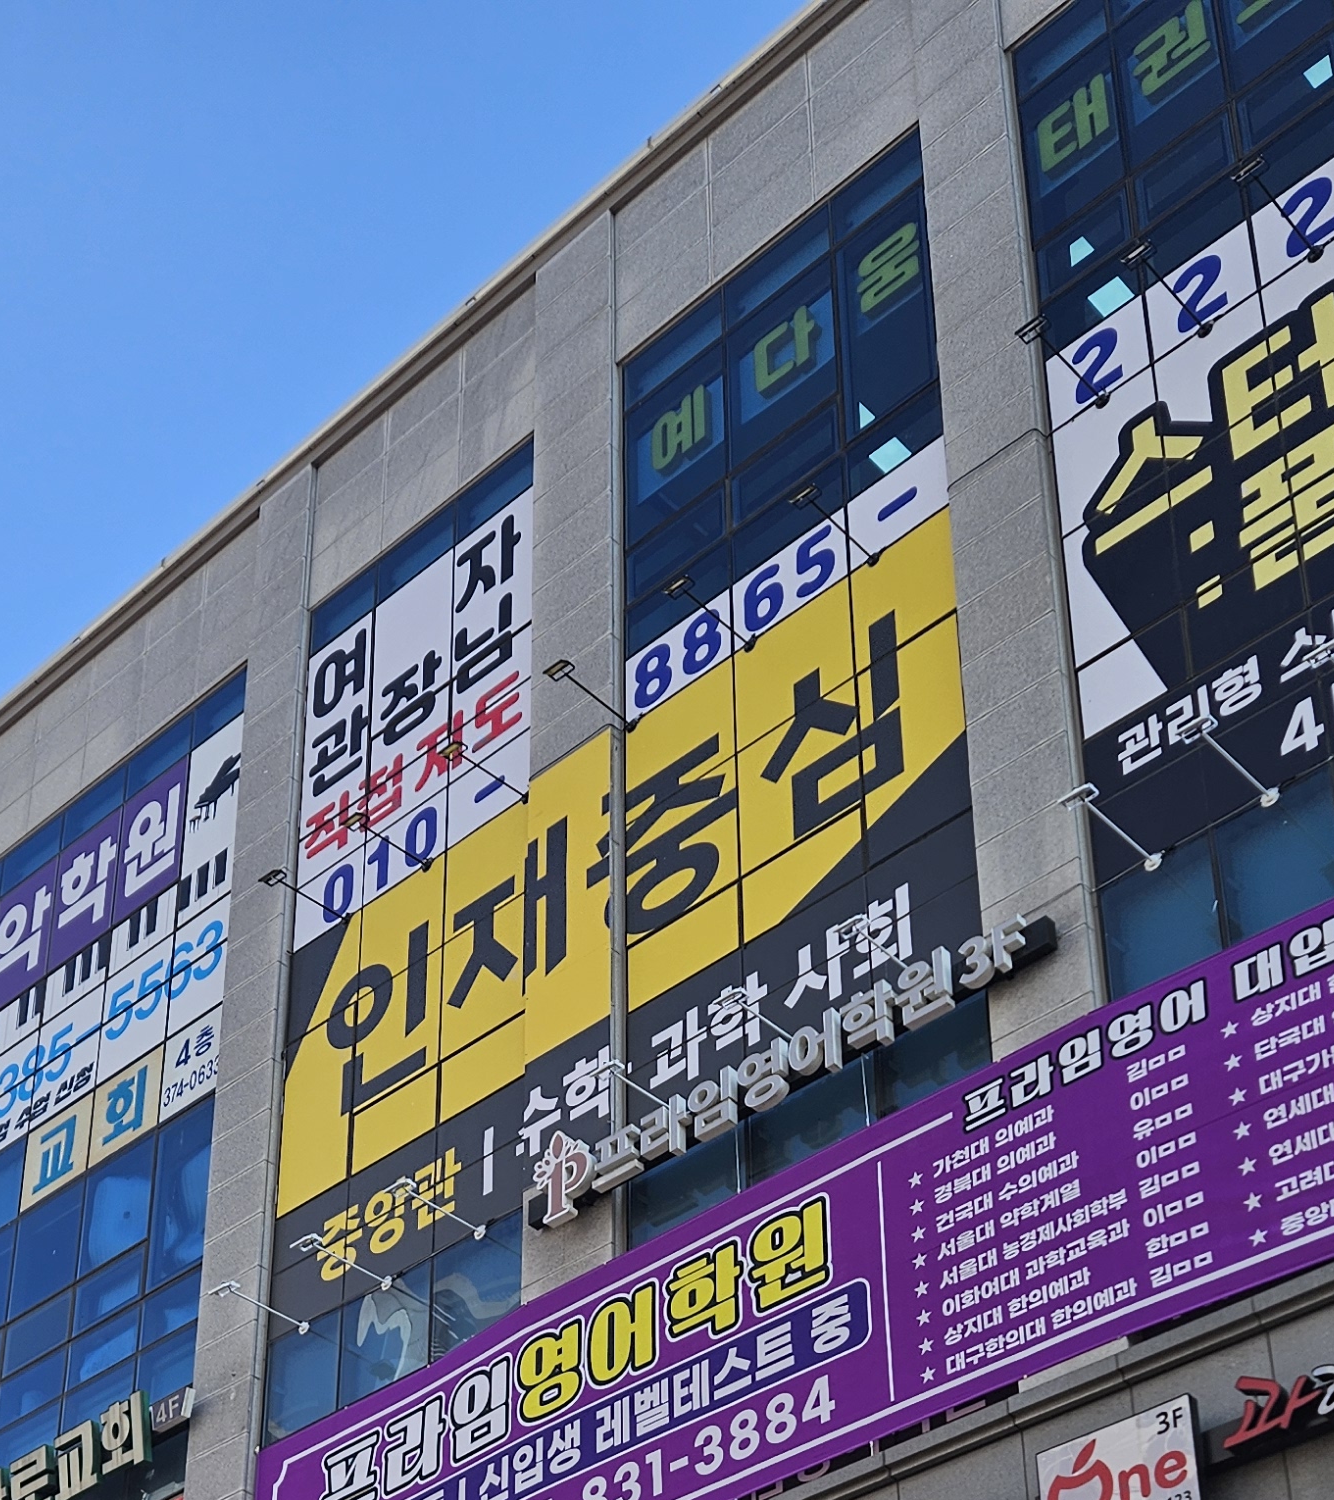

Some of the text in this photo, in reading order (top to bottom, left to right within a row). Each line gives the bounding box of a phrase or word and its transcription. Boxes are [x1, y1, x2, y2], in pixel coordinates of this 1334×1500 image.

[308, 592, 514, 798] 관장님
[1117, 654, 1261, 777] 관리형
[325, 608, 906, 1118] 인재중심
[649, 881, 914, 1089] 과학 사회
[1250, 979, 1322, 1029] 상지대
[174, 1023, 216, 1071] 4층
[591, 945, 957, 1195] 프라임영어학원
[963, 977, 1208, 1133] 프라임영어
[1253, 1013, 1327, 1062] 단국대
[30, 1063, 150, 1196] 교회
[932, 1104, 1056, 1180] 가천대 의예과
[934, 1130, 1058, 1206] 경북대 의예과
[935, 1149, 1080, 1234] 건국대 수의예과
[937, 1178, 1082, 1262] 서울대 약학계열
[939, 1186, 1130, 1291] 서울대 농경제사회학부
[941, 1217, 1132, 1319] 이화여대 과학교육과
[943, 1265, 1092, 1348] 상지대 한의예과
[594, 1318, 795, 1448] 레벨테스트
[811, 1292, 854, 1355] 중
[945, 1275, 1138, 1376] 대구한의대 한의예과
[1154, 1405, 1185, 1436] 3F
